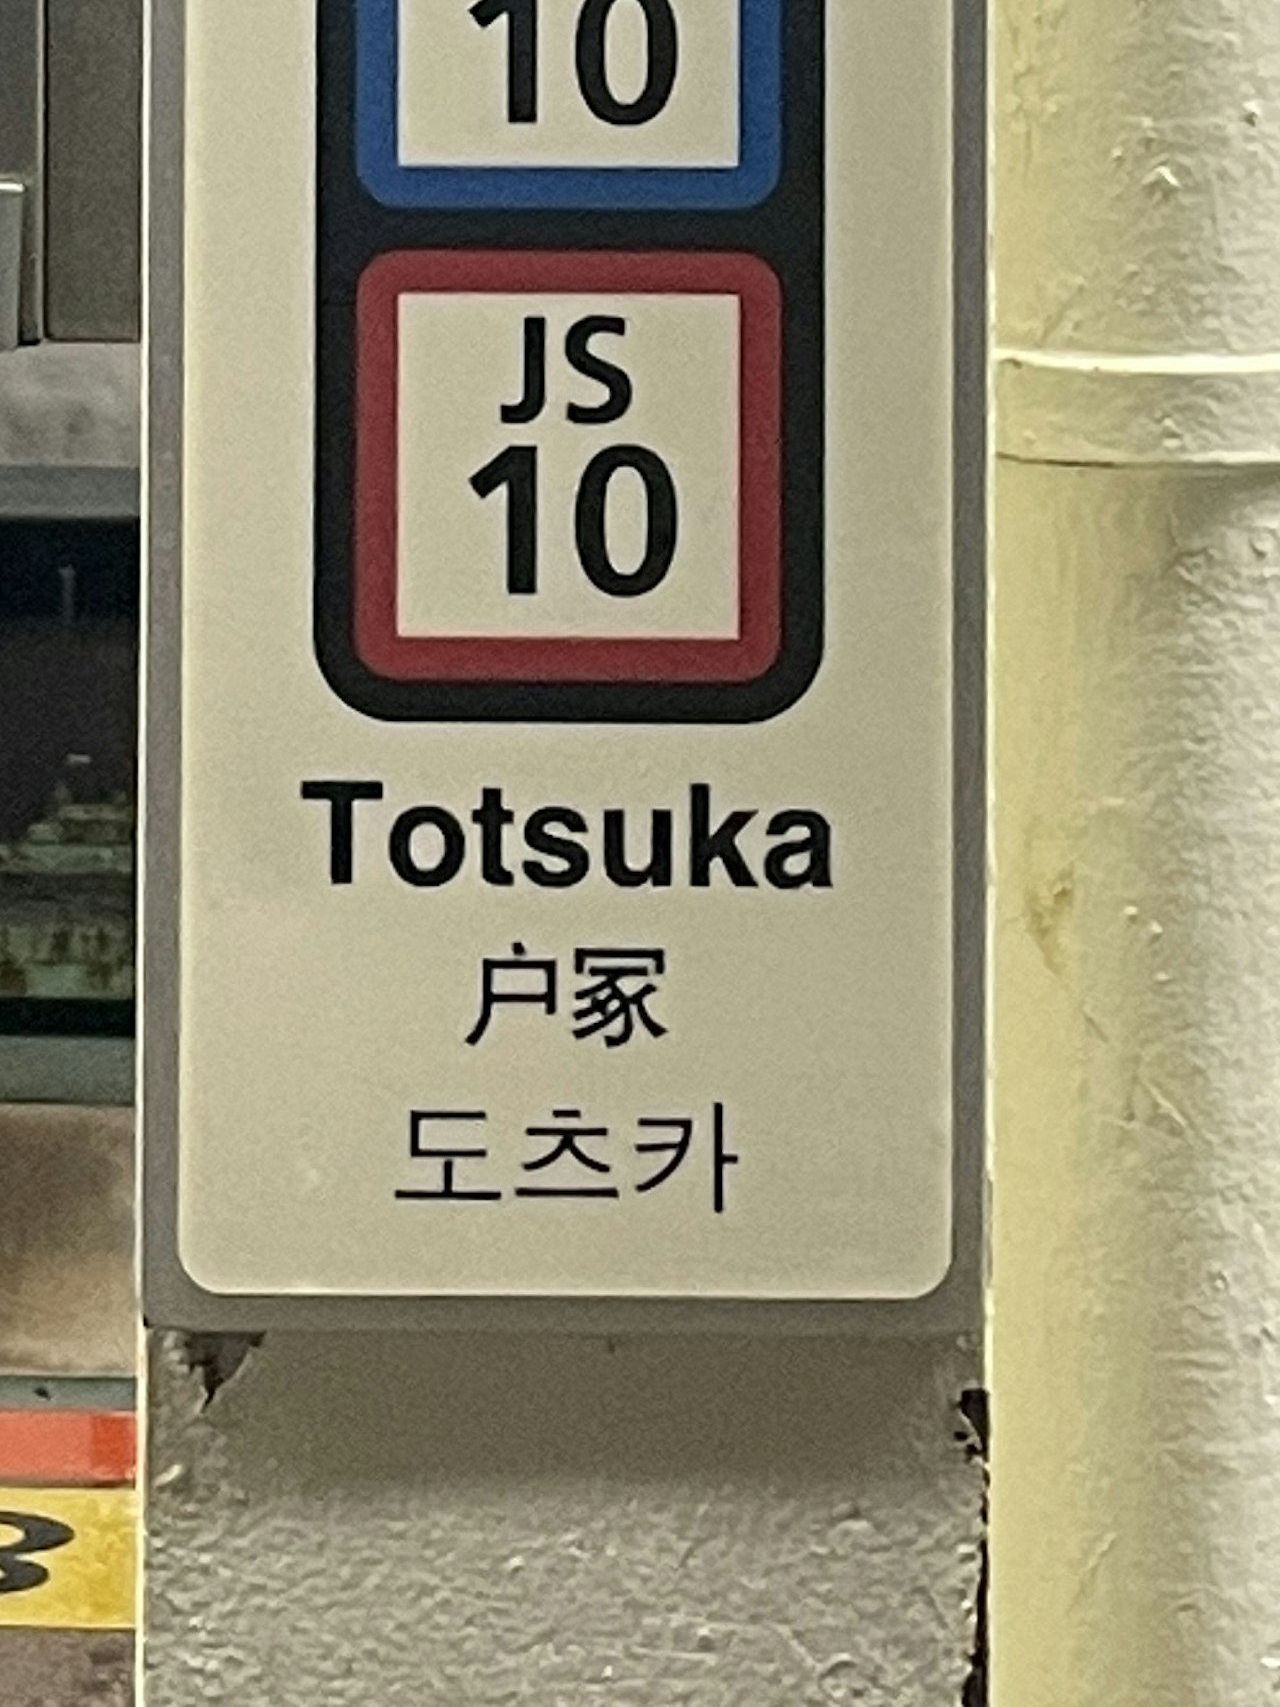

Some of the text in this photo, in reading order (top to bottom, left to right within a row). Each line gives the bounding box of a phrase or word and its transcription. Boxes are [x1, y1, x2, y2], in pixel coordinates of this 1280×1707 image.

[500, 315, 632, 424] JS
[468, 444, 678, 597] 10
[301, 780, 833, 888] Totsuka
[394, 1102, 738, 1213] 도츠카
